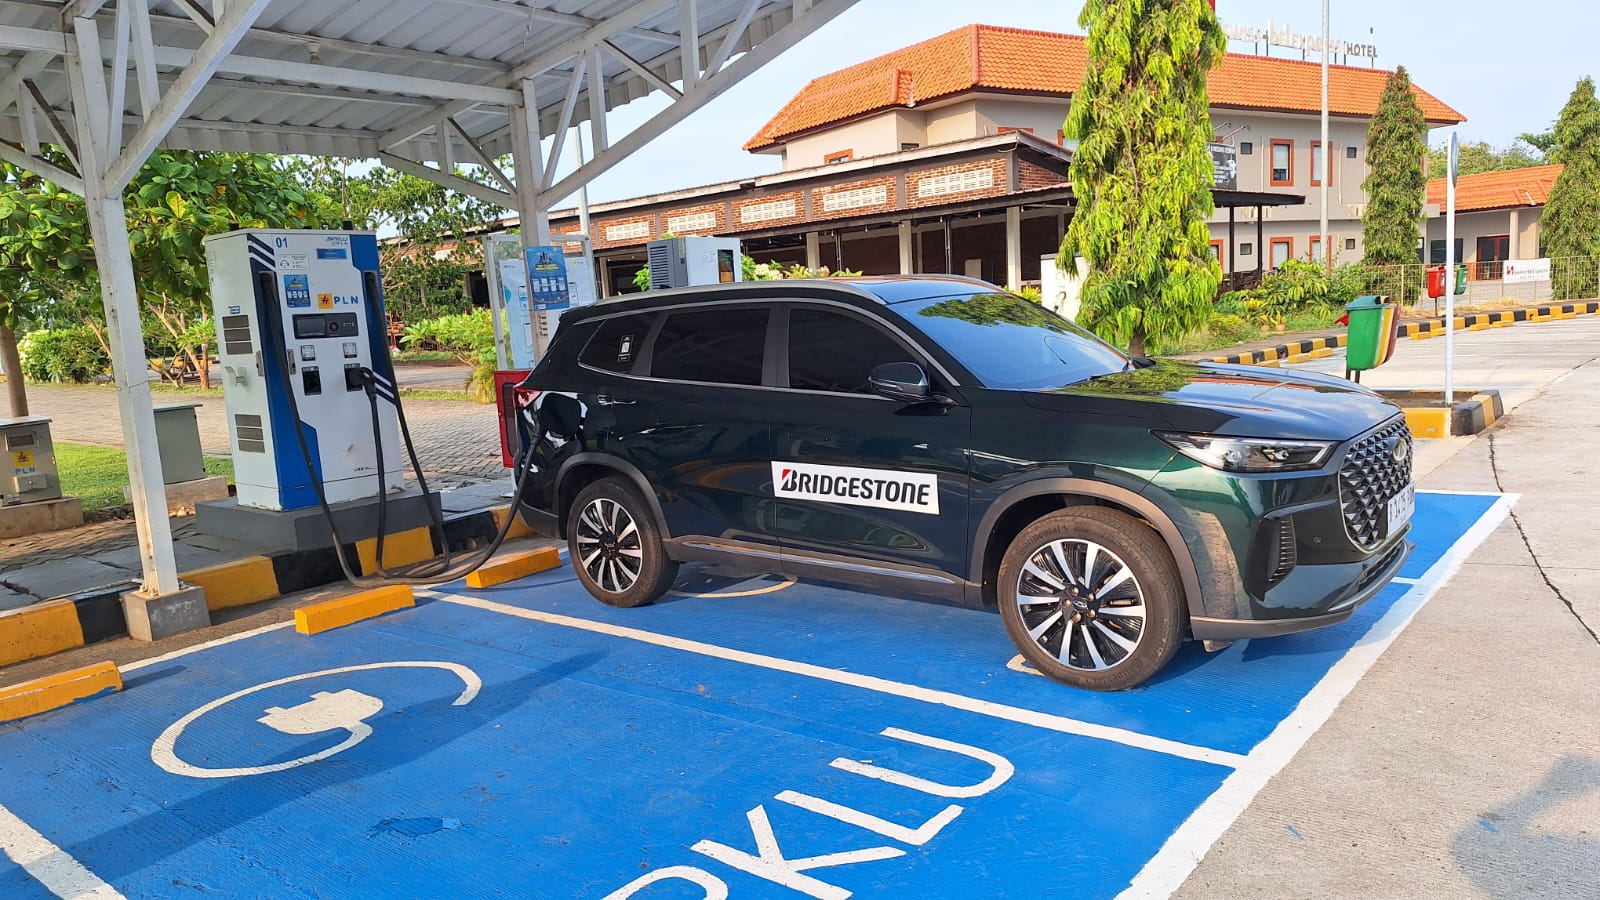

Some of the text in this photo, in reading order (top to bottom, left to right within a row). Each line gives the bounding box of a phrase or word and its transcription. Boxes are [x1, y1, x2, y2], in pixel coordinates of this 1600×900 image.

[1346, 42, 1377, 58] HOTEL
[276, 236, 288, 248] 01
[333, 295, 359, 304] PLN
[15, 466, 36, 474] PLN
[780, 468, 931, 506] BRIDGESTONE
